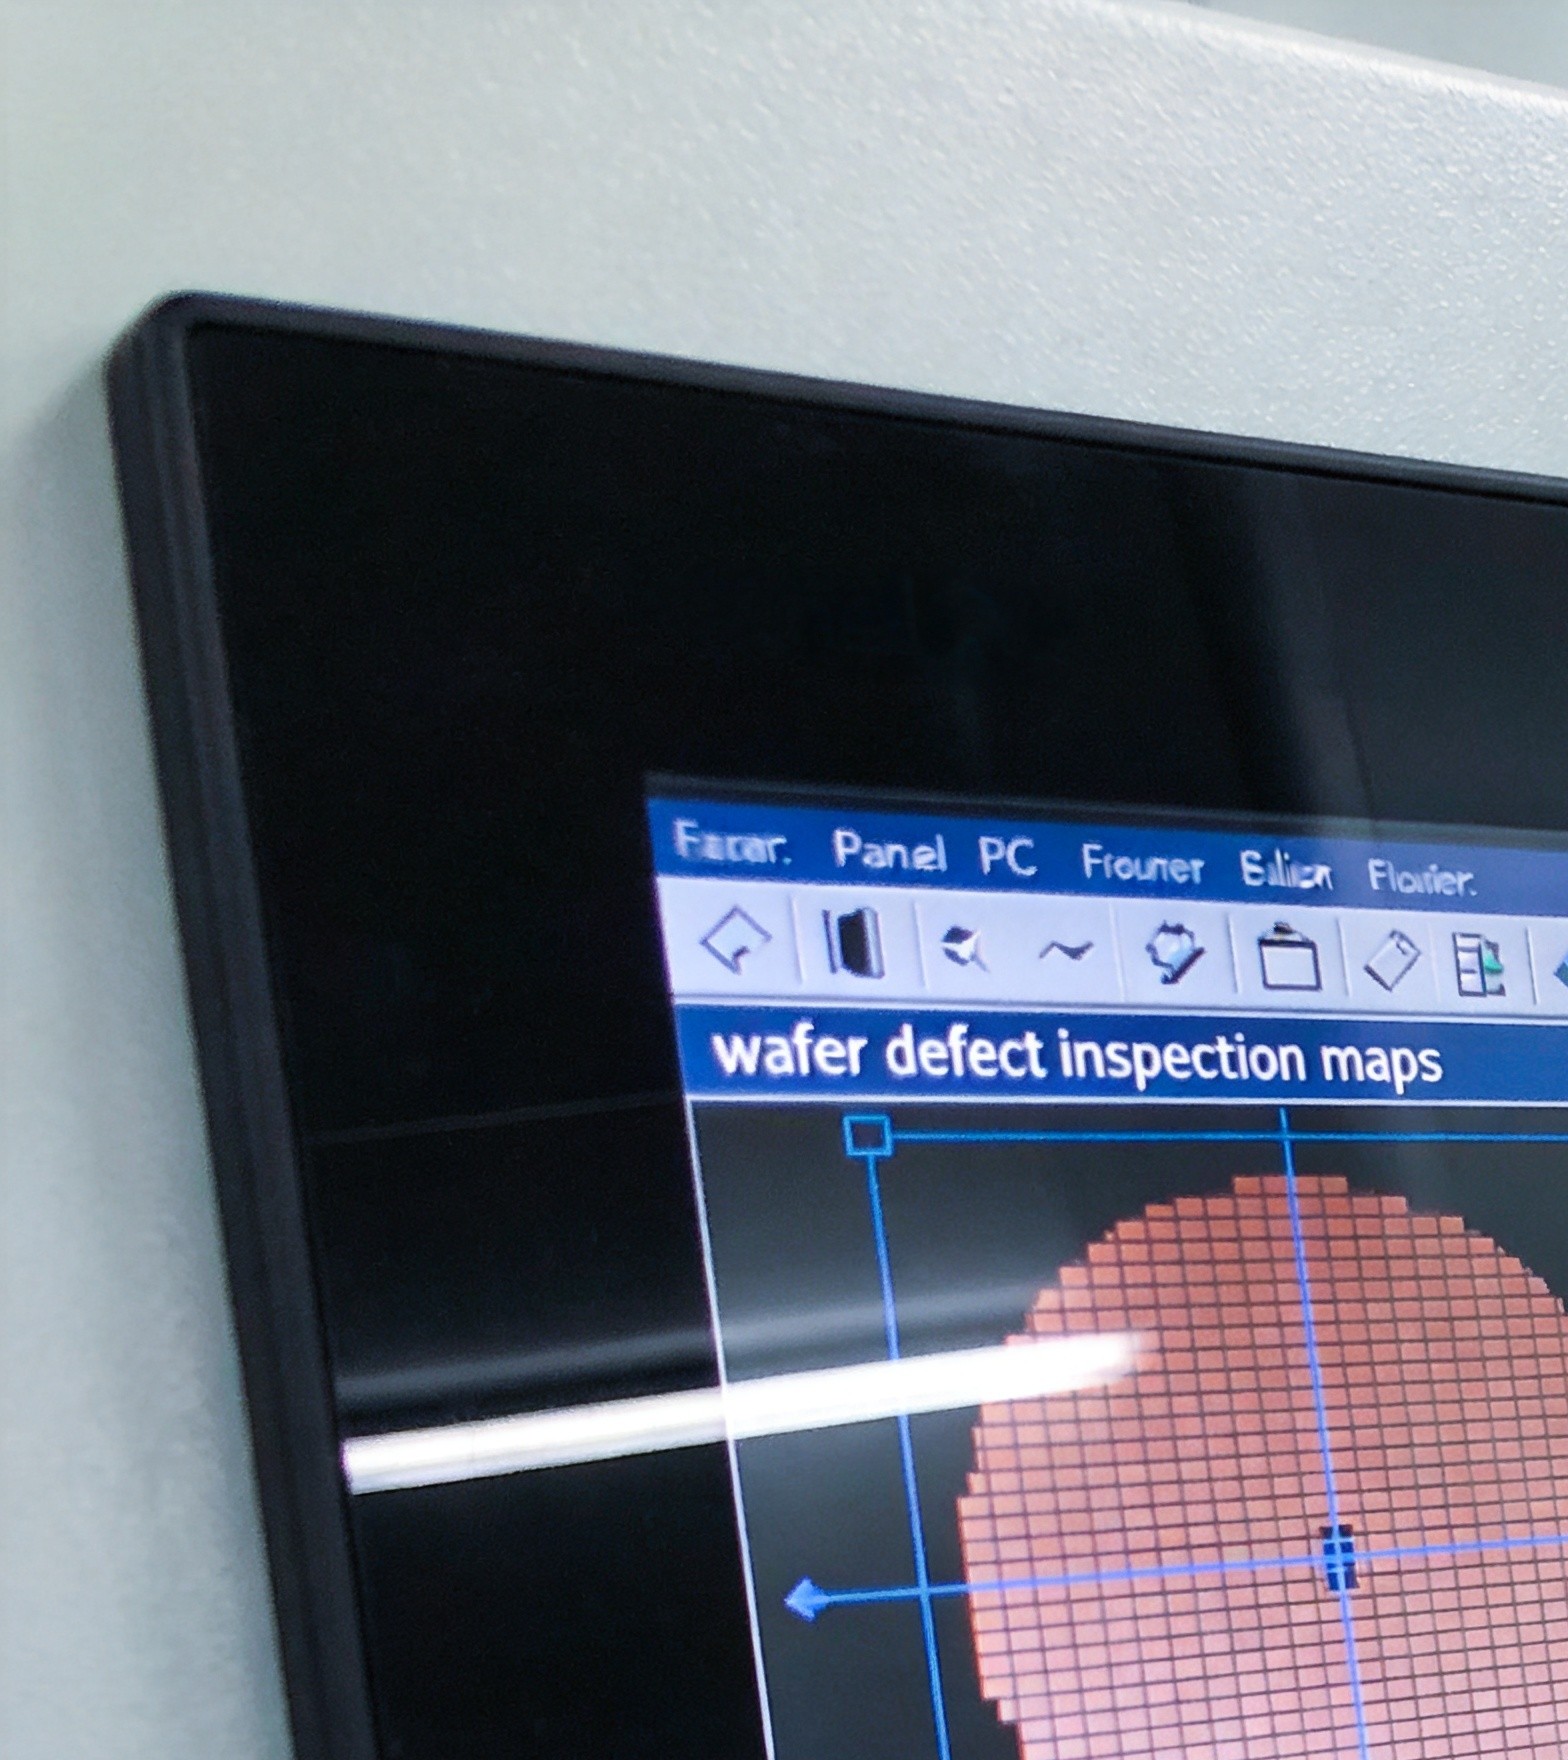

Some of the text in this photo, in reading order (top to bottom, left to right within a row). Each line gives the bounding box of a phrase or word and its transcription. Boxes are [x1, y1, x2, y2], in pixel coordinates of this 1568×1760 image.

[832, 826, 948, 872] Panel
[978, 835, 1038, 877] PC
[712, 1020, 1444, 1094] wafer defect inspection maps
